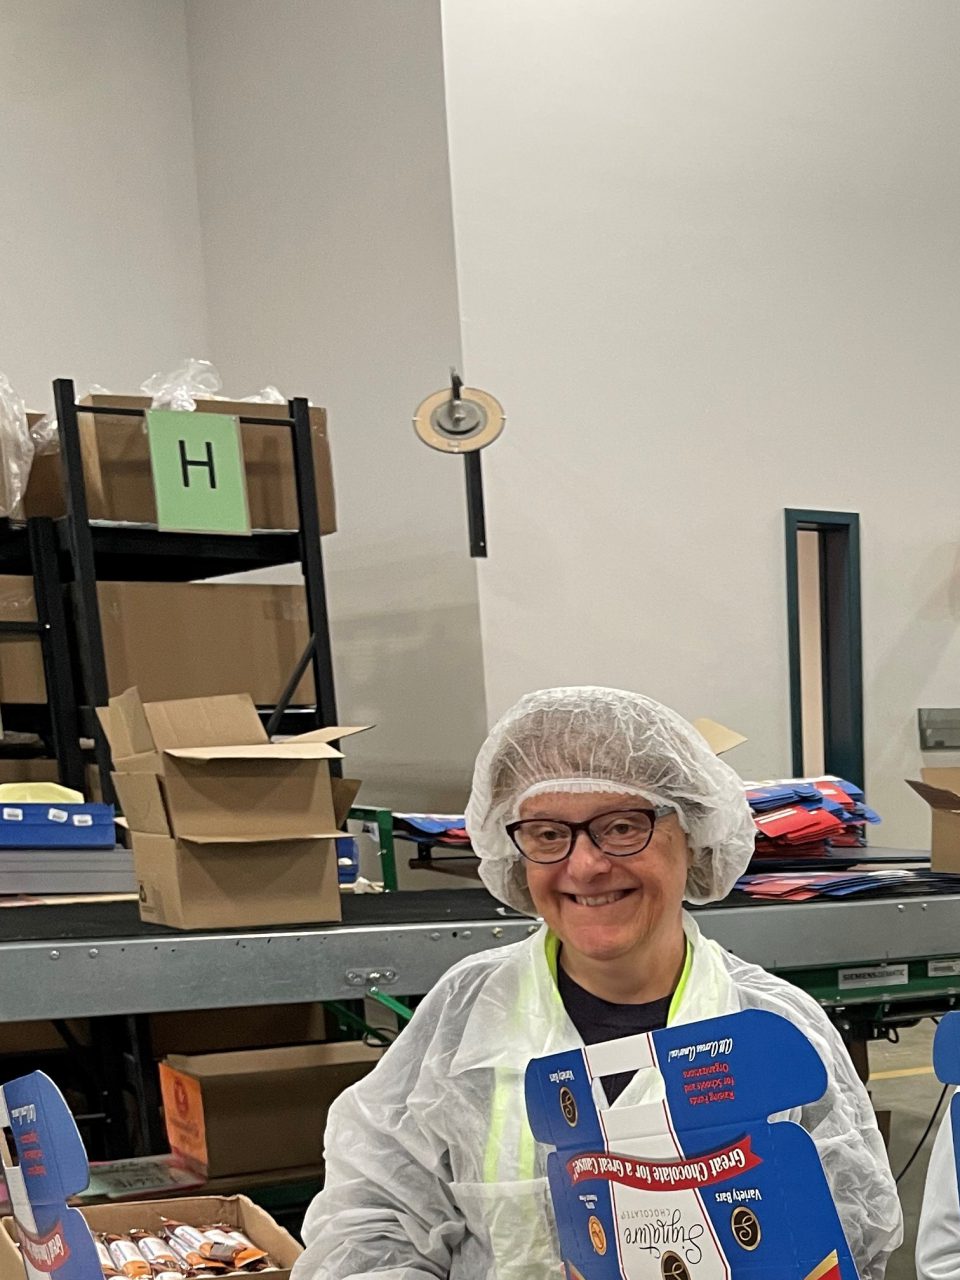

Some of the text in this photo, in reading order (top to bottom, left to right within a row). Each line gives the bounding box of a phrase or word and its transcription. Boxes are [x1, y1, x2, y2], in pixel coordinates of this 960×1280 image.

[179, 440, 216, 489] H
[558, 1070, 575, 1083] Variety
[600, 1157, 624, 1177] Great
[626, 1162, 632, 1175] a
[709, 1148, 746, 1174] Great
[635, 1165, 651, 1183] for
[653, 1164, 708, 1185] Chocolate
[715, 1188, 762, 1203] Variety Bars
[624, 1208, 704, 1264] Signature
